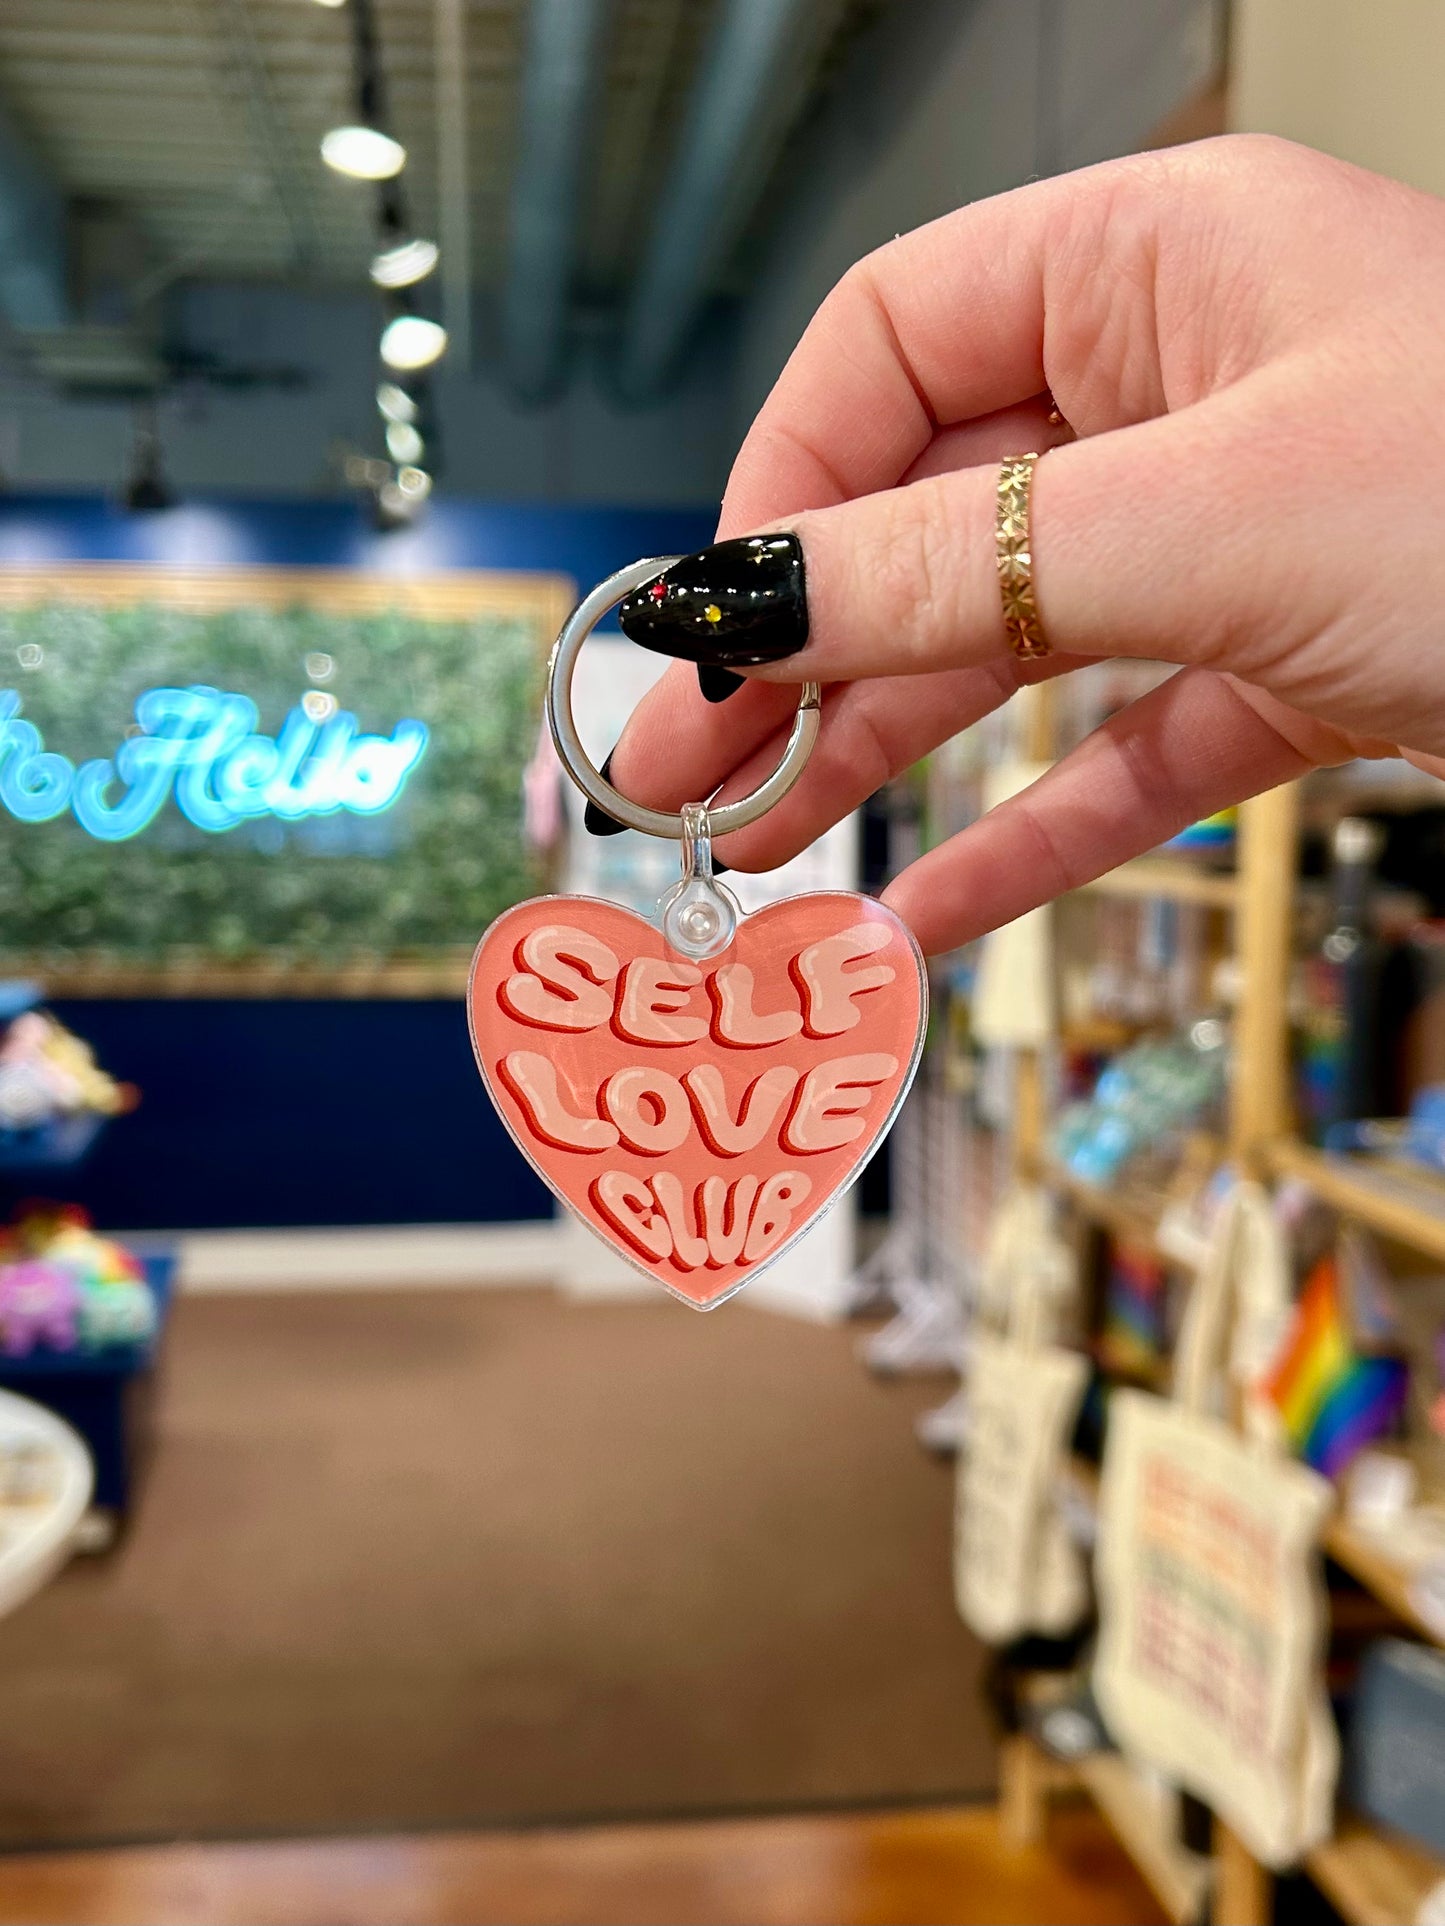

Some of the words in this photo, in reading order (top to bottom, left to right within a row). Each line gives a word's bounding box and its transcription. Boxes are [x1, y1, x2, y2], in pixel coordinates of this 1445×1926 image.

[496, 922, 896, 1050] SELF
[496, 1050, 899, 1159] LOVE
[588, 1170, 812, 1273] CLUB
